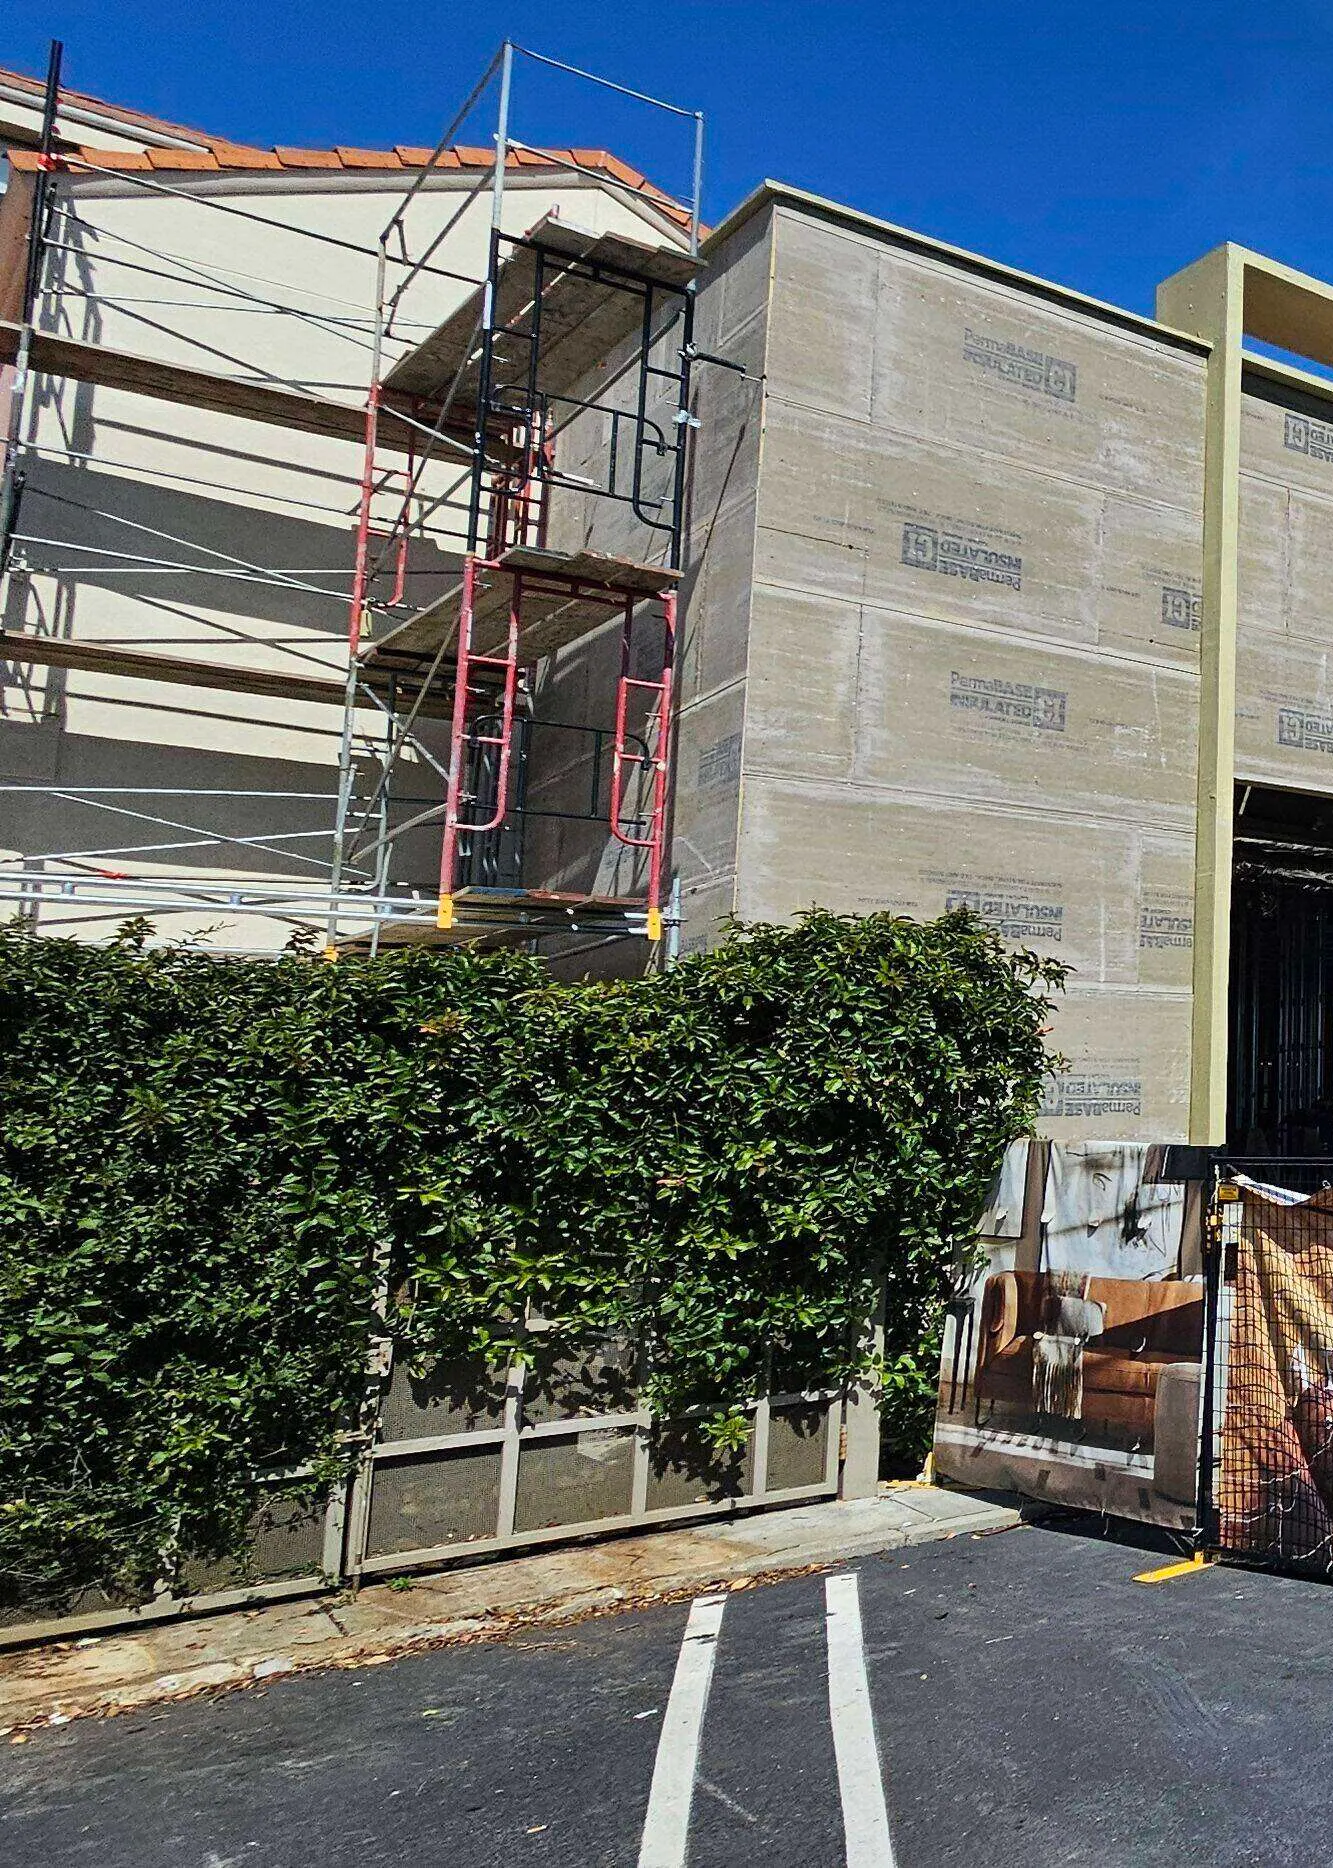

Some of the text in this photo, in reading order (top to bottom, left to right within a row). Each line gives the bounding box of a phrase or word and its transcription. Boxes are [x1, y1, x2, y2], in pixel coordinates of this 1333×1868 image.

[964, 327, 1043, 365] PermaBASE
[940, 539, 1022, 569] INSULATED
[939, 561, 1021, 591] PermaBASE
[951, 670, 1033, 699] PermaBASE
[1065, 1101, 1141, 1117] PermaBASE
